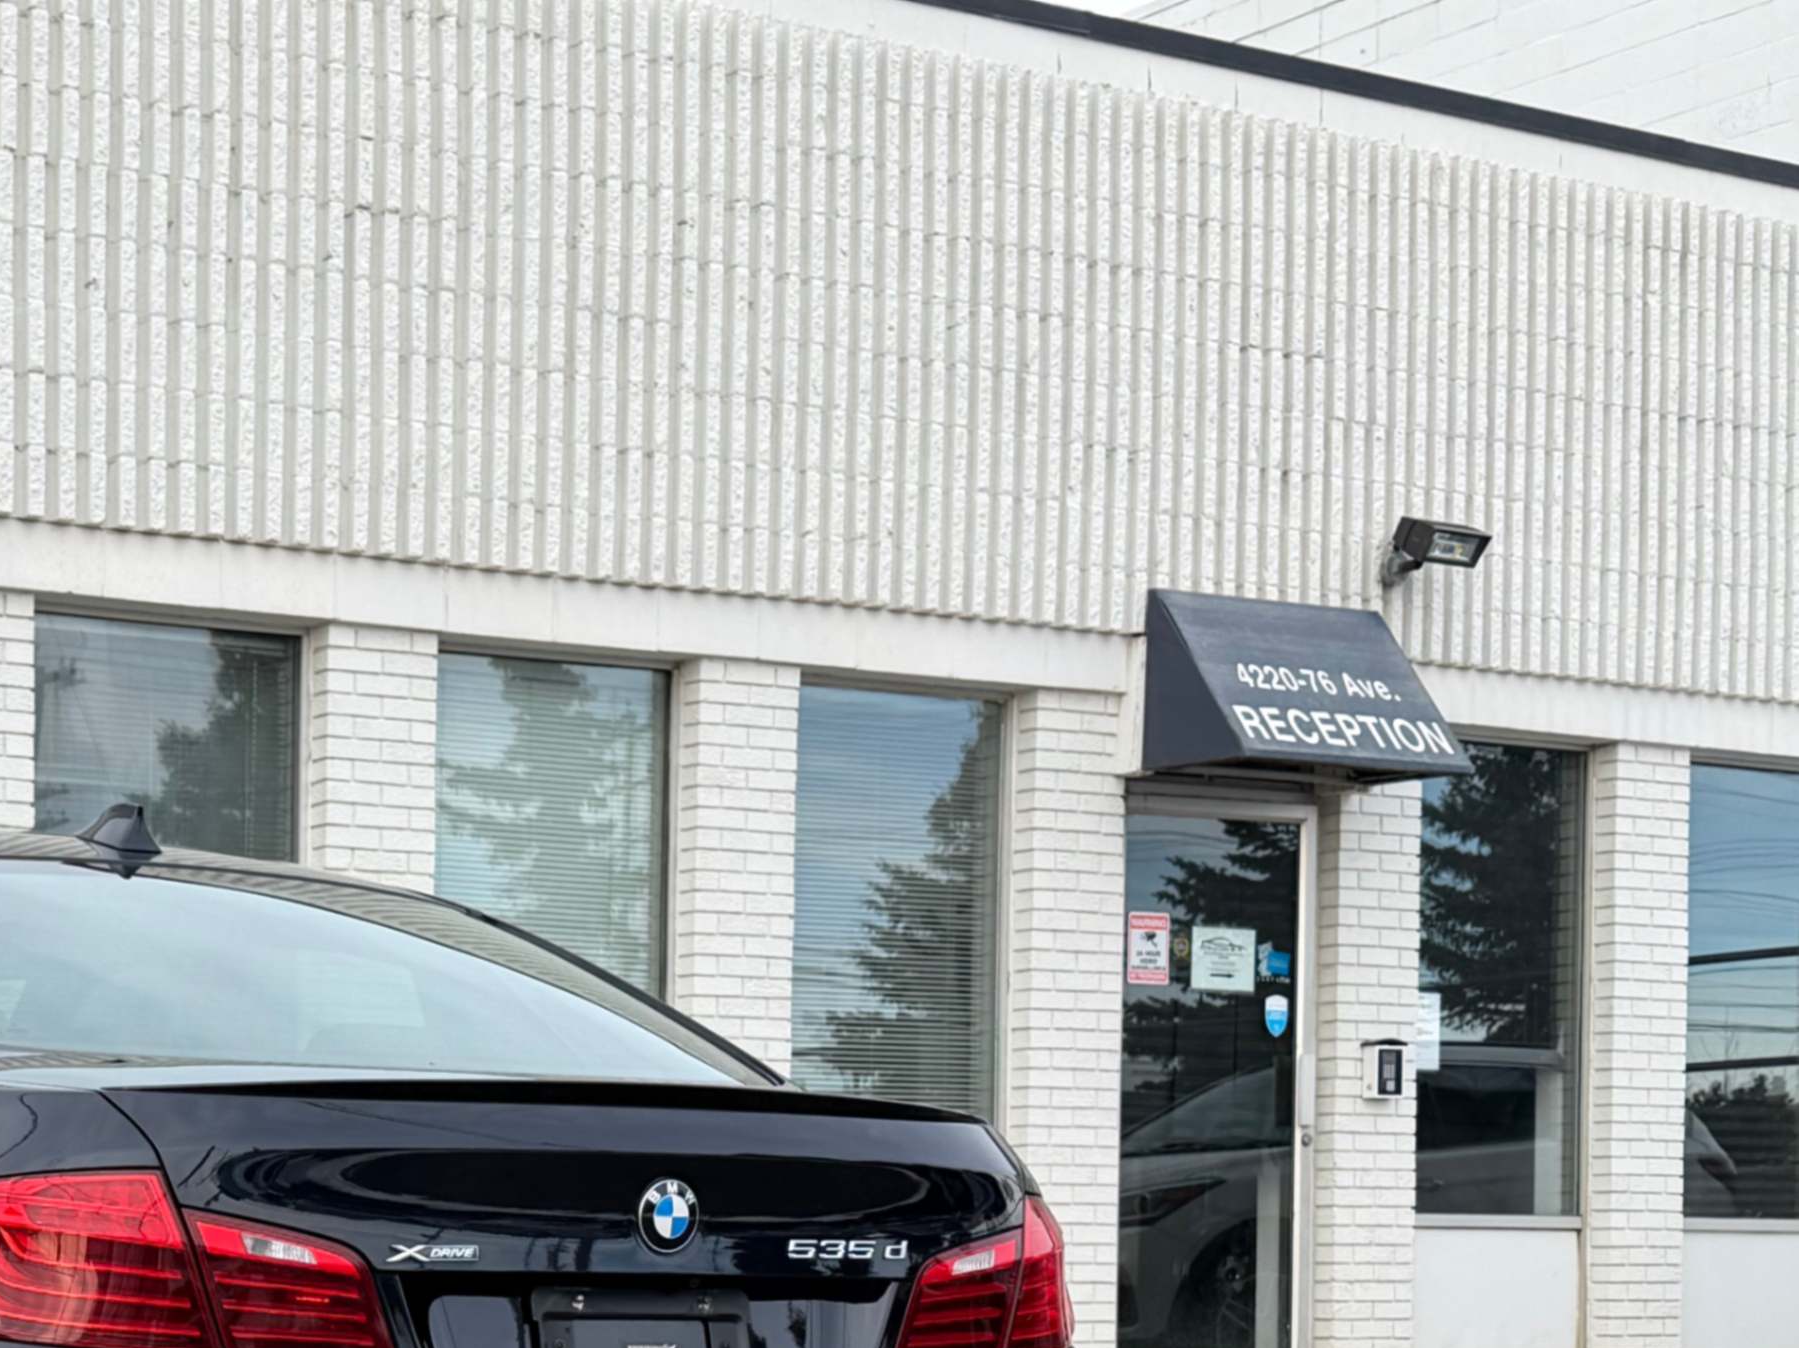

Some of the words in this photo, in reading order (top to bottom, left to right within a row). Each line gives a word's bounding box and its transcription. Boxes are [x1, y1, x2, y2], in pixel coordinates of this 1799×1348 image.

[1236, 663, 1337, 696] 4220-76
[1341, 672, 1402, 702] Ave.
[1232, 704, 1455, 755] RECEPTION
[648, 1181, 697, 1206] BMW
